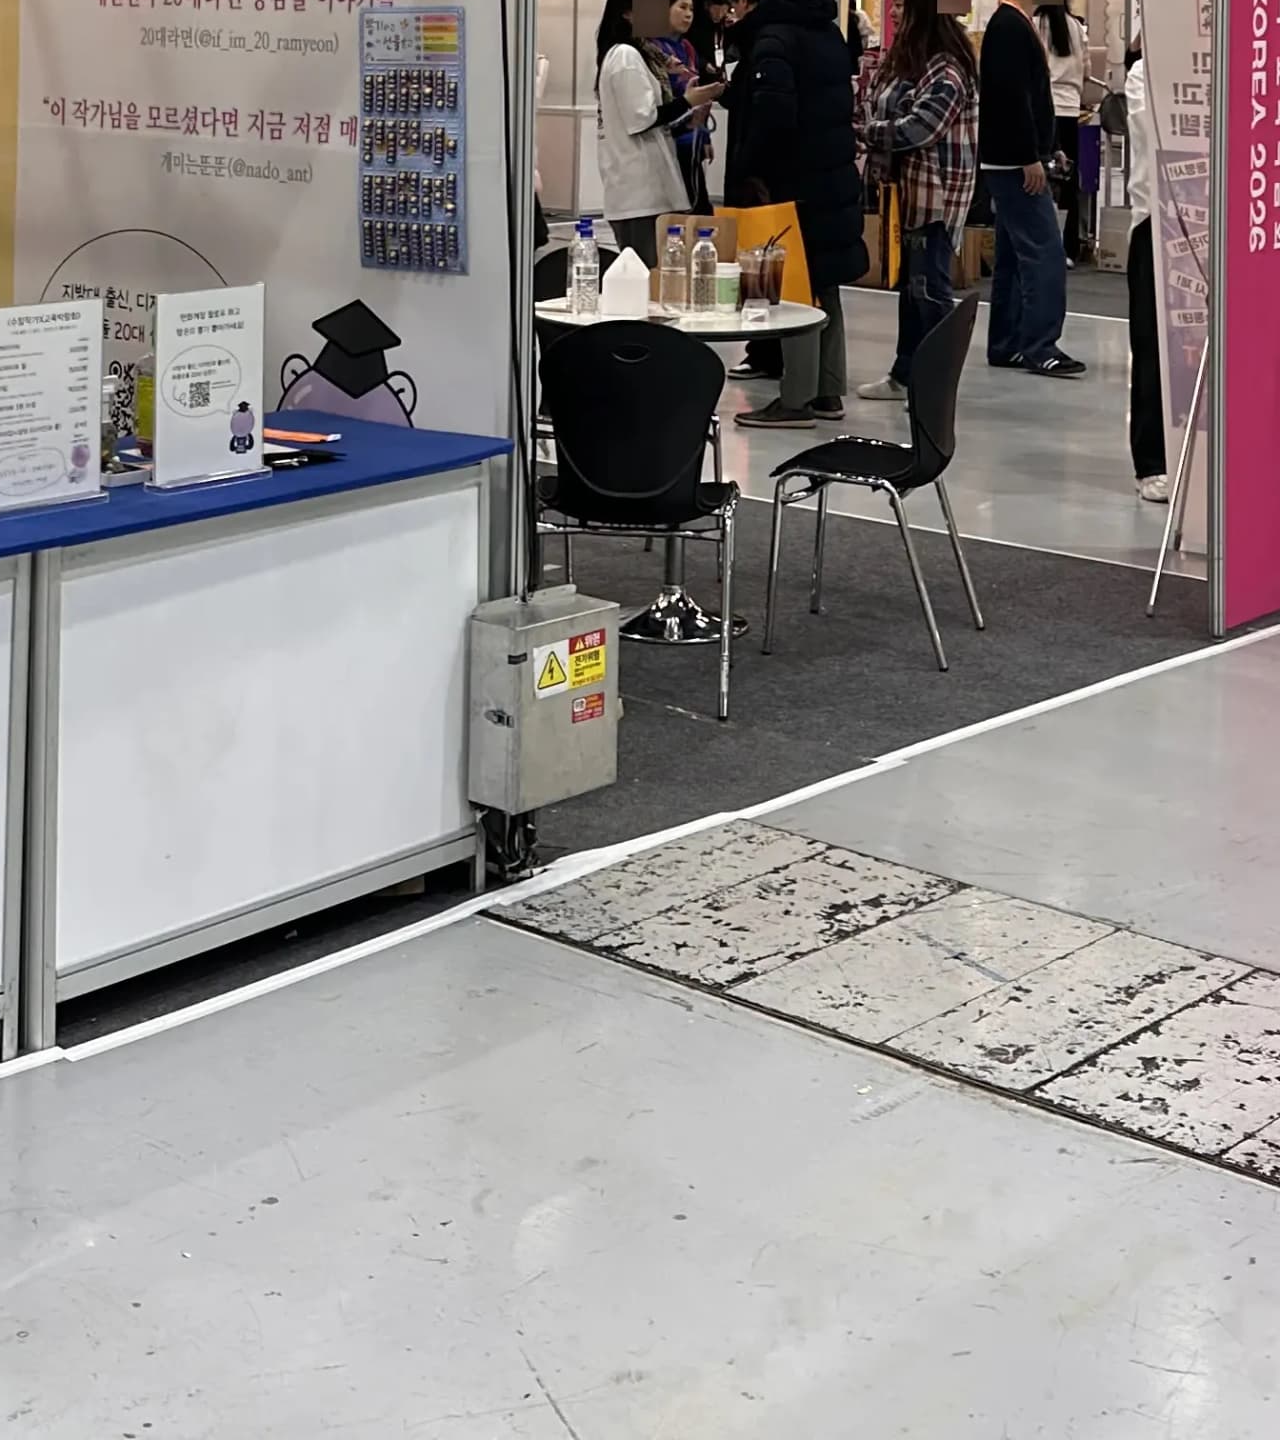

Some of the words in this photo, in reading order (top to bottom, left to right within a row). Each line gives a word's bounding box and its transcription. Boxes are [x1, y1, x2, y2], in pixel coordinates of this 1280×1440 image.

[71, 99, 141, 131] 작가님을
[145, 104, 239, 139] 모르셨다면
[246, 109, 287, 141] 지금
[291, 114, 331, 145] 저점
[1248, 143, 1267, 253] 2026
